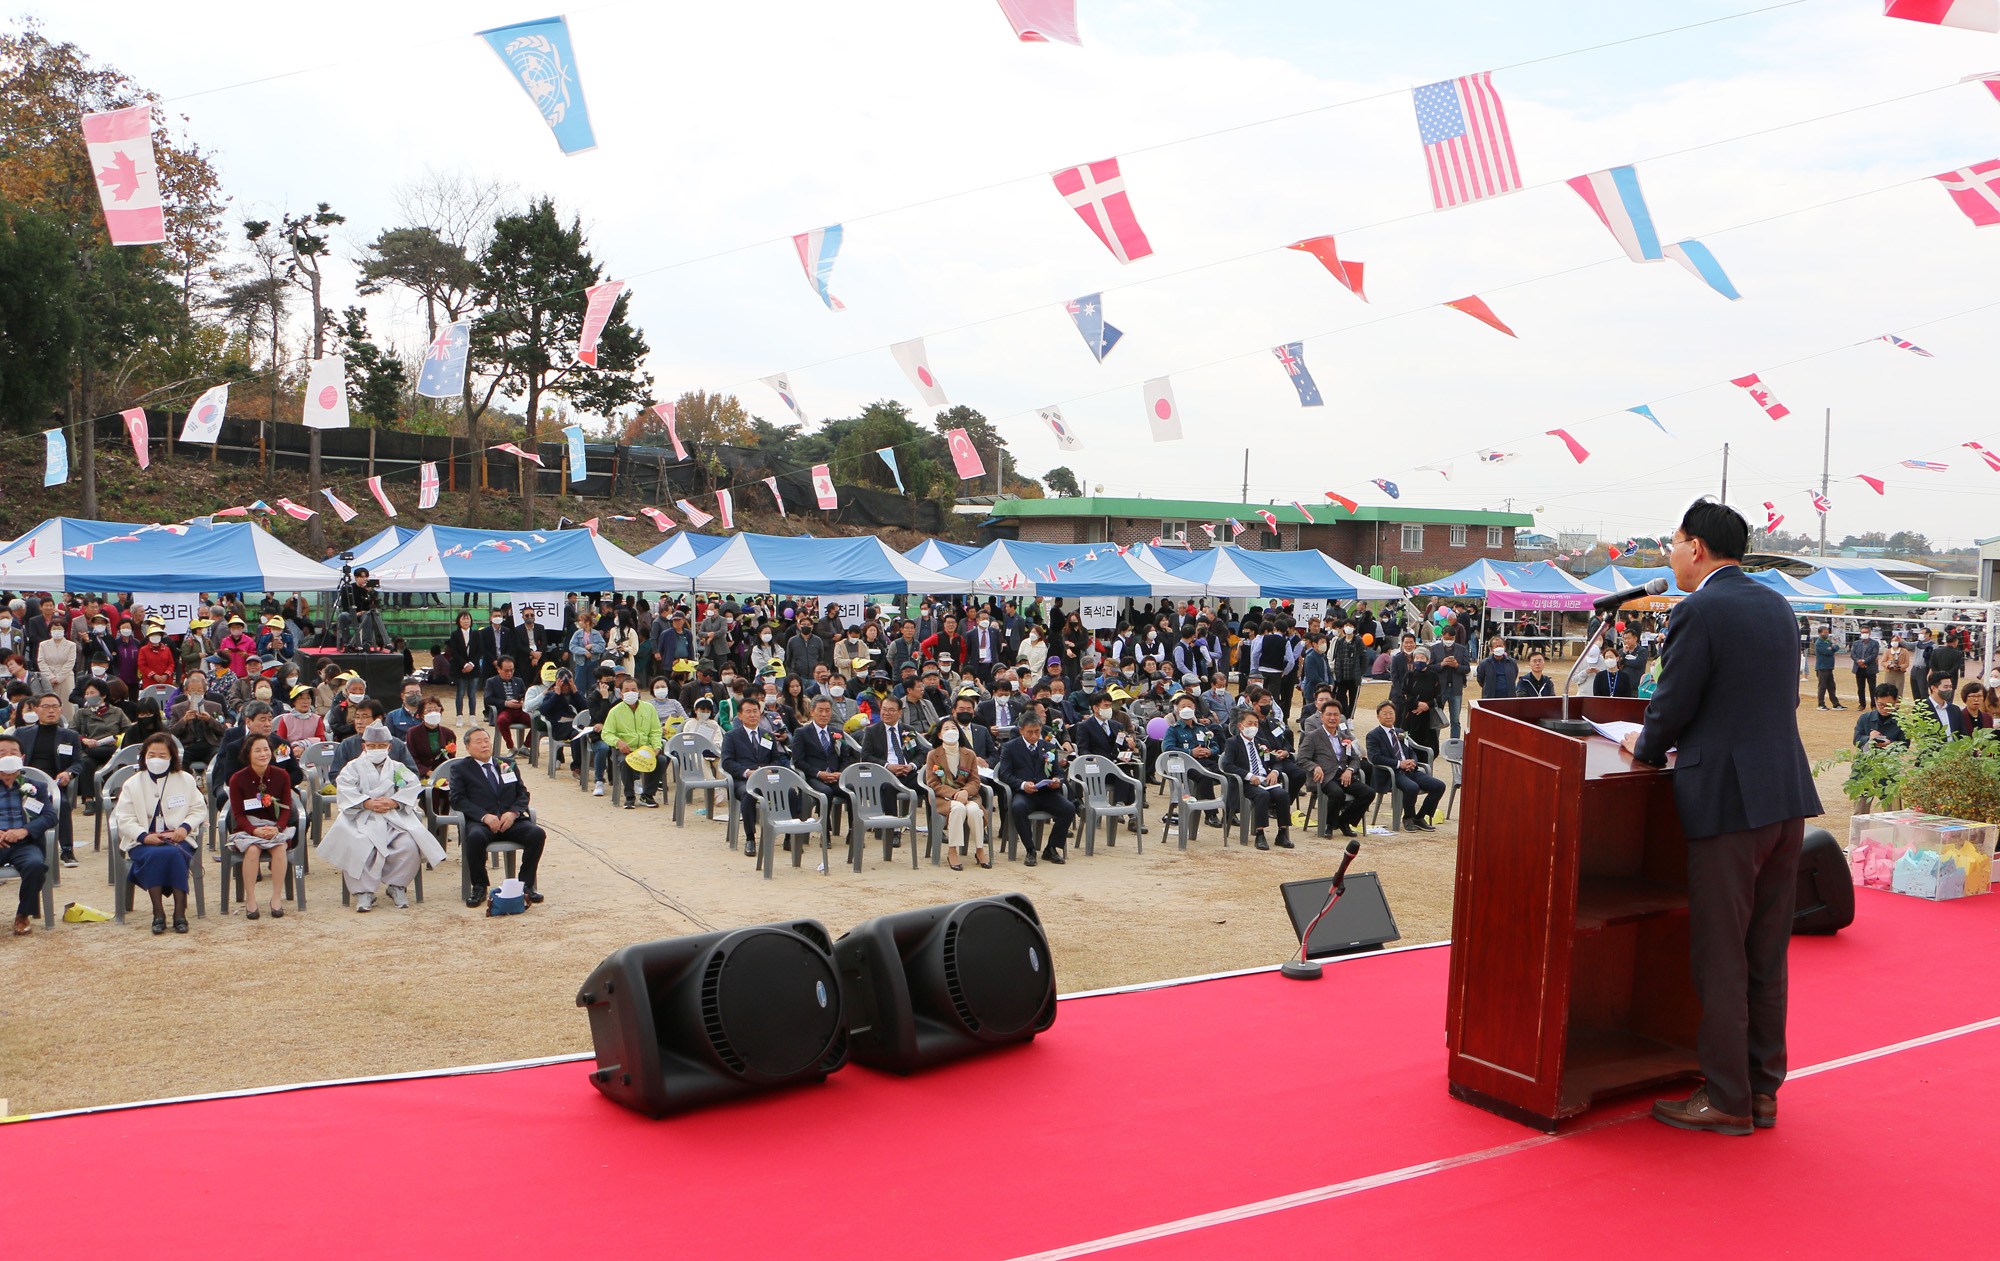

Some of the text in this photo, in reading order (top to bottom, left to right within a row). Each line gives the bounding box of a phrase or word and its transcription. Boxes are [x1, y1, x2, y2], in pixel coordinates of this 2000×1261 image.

[144, 604, 193, 620] 송현리
[824, 603, 860, 618] 천리
[1083, 605, 1115, 618] 죽석2리
